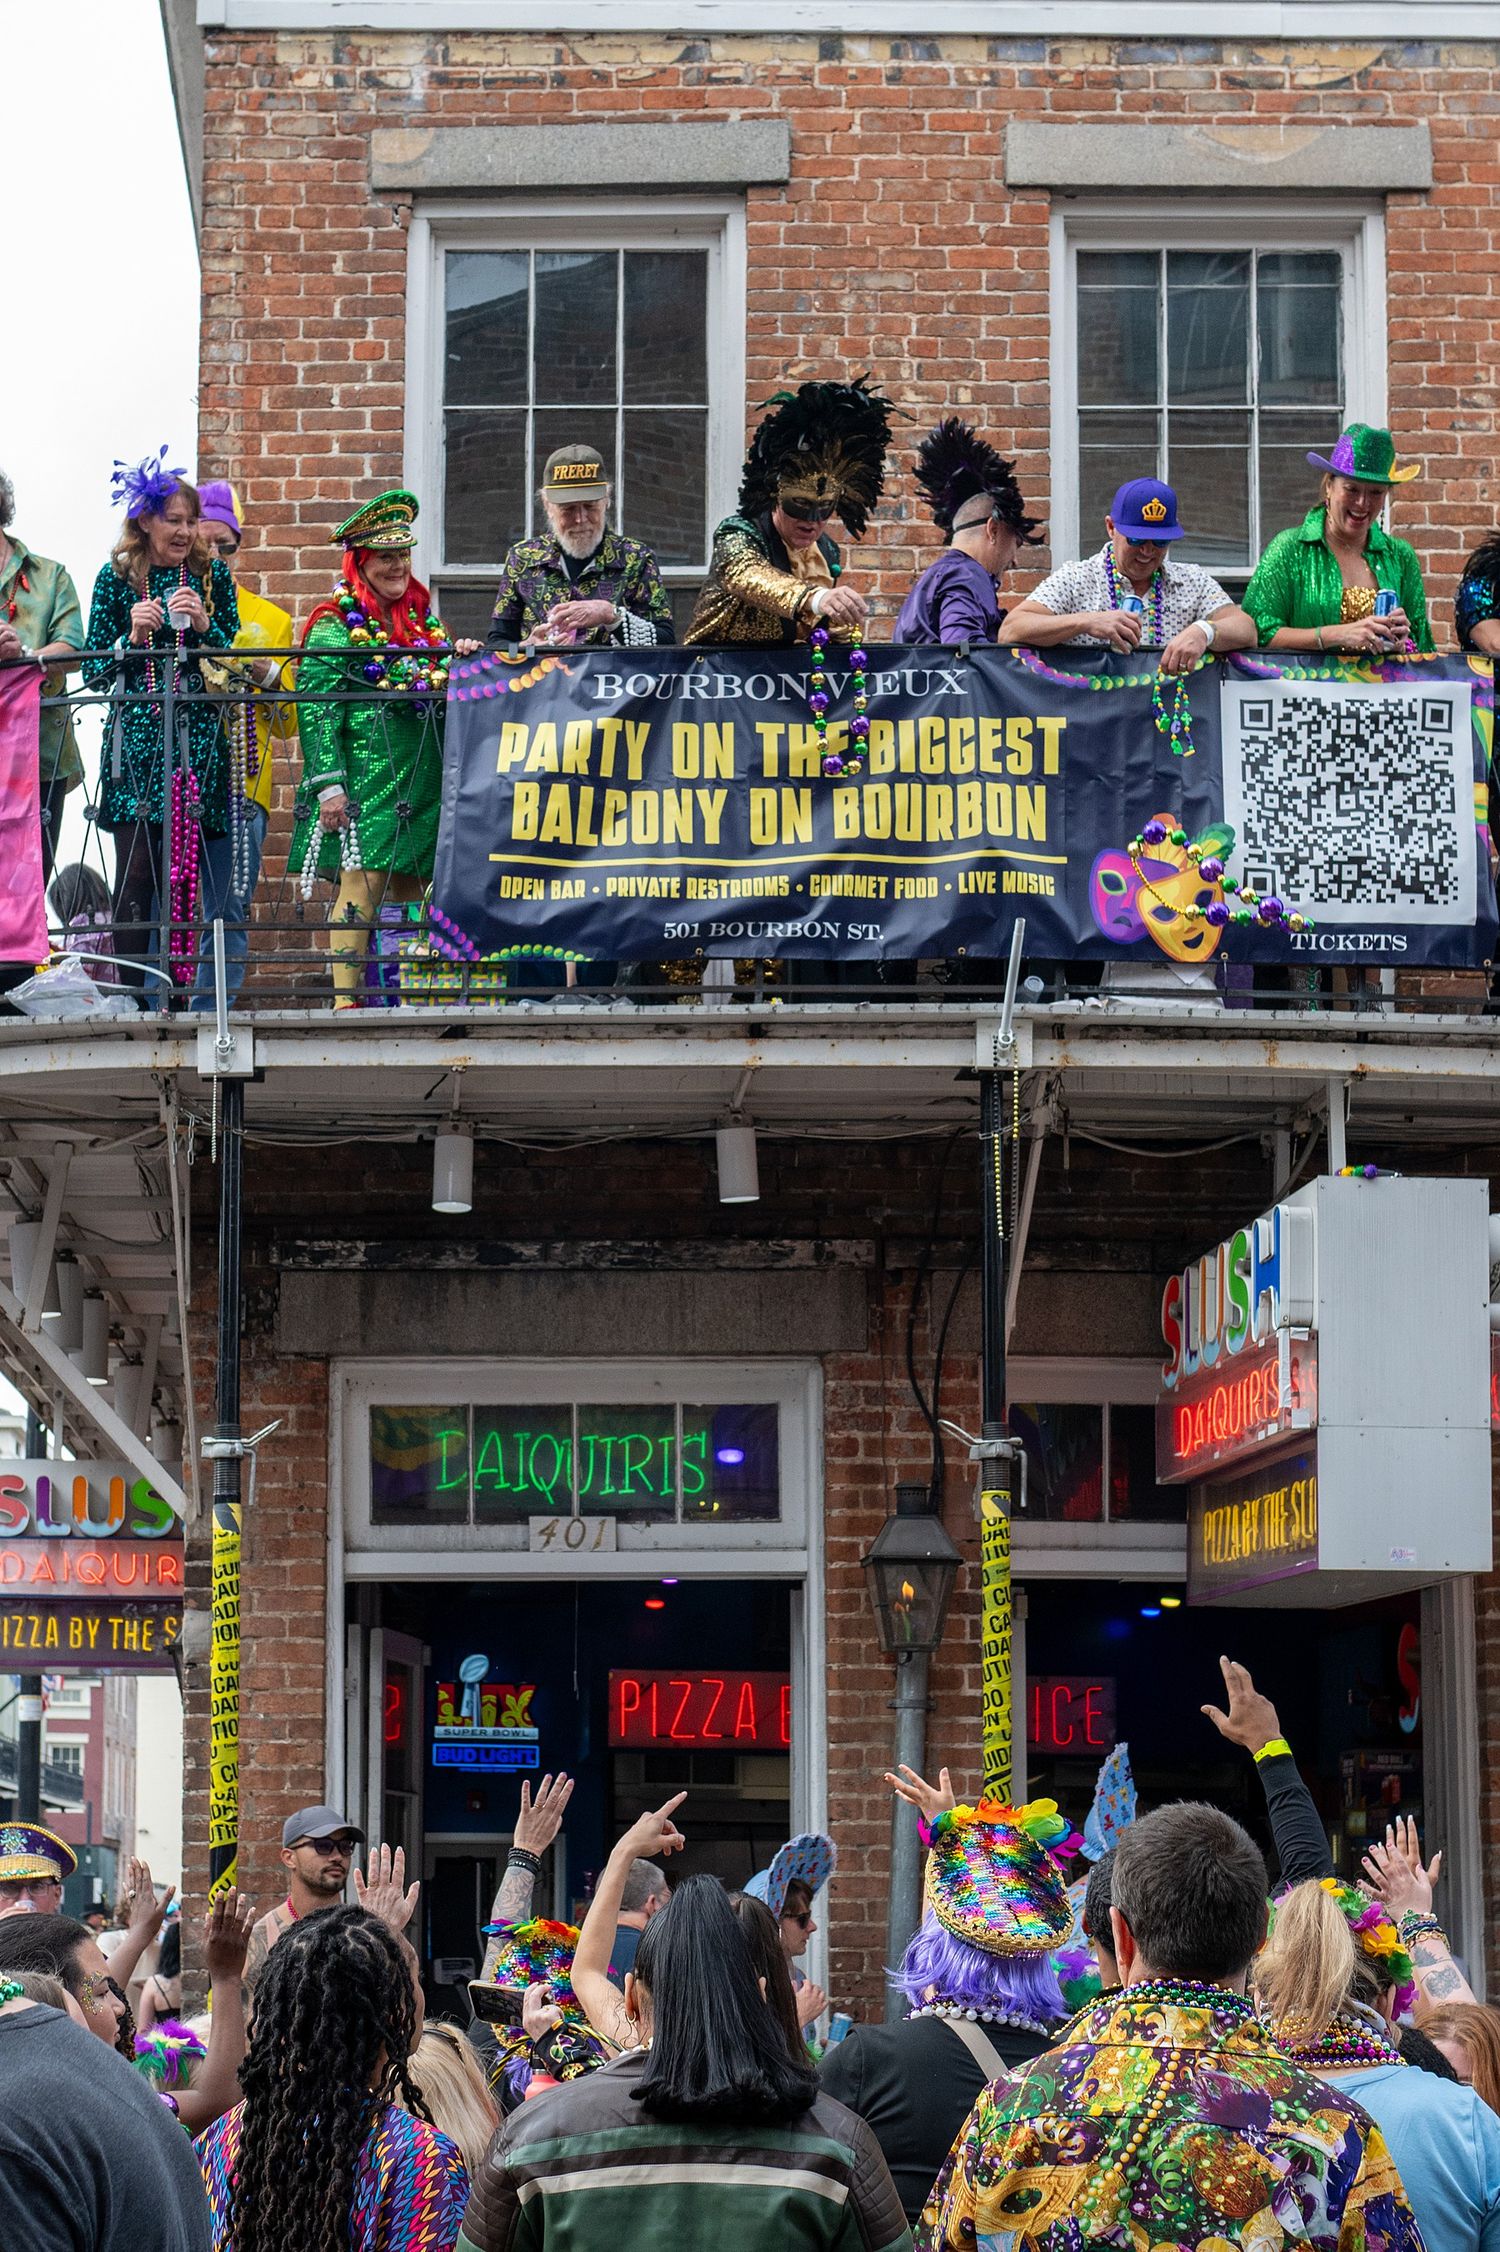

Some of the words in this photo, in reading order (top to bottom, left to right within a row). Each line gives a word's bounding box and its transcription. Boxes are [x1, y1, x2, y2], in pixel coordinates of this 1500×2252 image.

[553, 463, 600, 481] FRERET
[593, 671, 818, 701] BOURBON
[497, 717, 651, 781] PARTY
[673, 721, 735, 779] ON
[755, 721, 851, 780] THE
[869, 716, 1067, 776] BIGGEST
[511, 782, 728, 847] BALCONY
[750, 787, 813, 846] ON
[833, 781, 1047, 842] BOURBON
[500, 875, 545, 900] OPEN
[551, 878, 585, 900] BAR
[606, 875, 680, 899] PRIVATE
[686, 875, 790, 900] RESTROOMS
[809, 873, 889, 899] GOURMET
[894, 876, 938, 899] FOOD
[958, 871, 997, 894] LIVE
[1002, 871, 1055, 896] MUSIC
[663, 921, 701, 939] 501
[709, 921, 840, 939] BOURBON
[847, 923, 885, 941] ST.
[1290, 933, 1408, 952] TICKETS
[1161, 1204, 1289, 1389] SLUSH
[435, 1429, 707, 1504] DAIQUIRIS
[0, 1474, 174, 1538] SLUS
[538, 1517, 607, 1550] 401
[1203, 1504, 1240, 1567] PIZZA
[1263, 1487, 1289, 1551] THE
[69, 1616, 100, 1649] BY
[108, 1616, 154, 1652] THE
[619, 1678, 757, 1740] PIZZA
[443, 1728, 487, 1737] SUPER
[492, 1728, 530, 1737] BOWL
[437, 1747, 478, 1763] BUD
[480, 1748, 537, 1764] LIGHT
